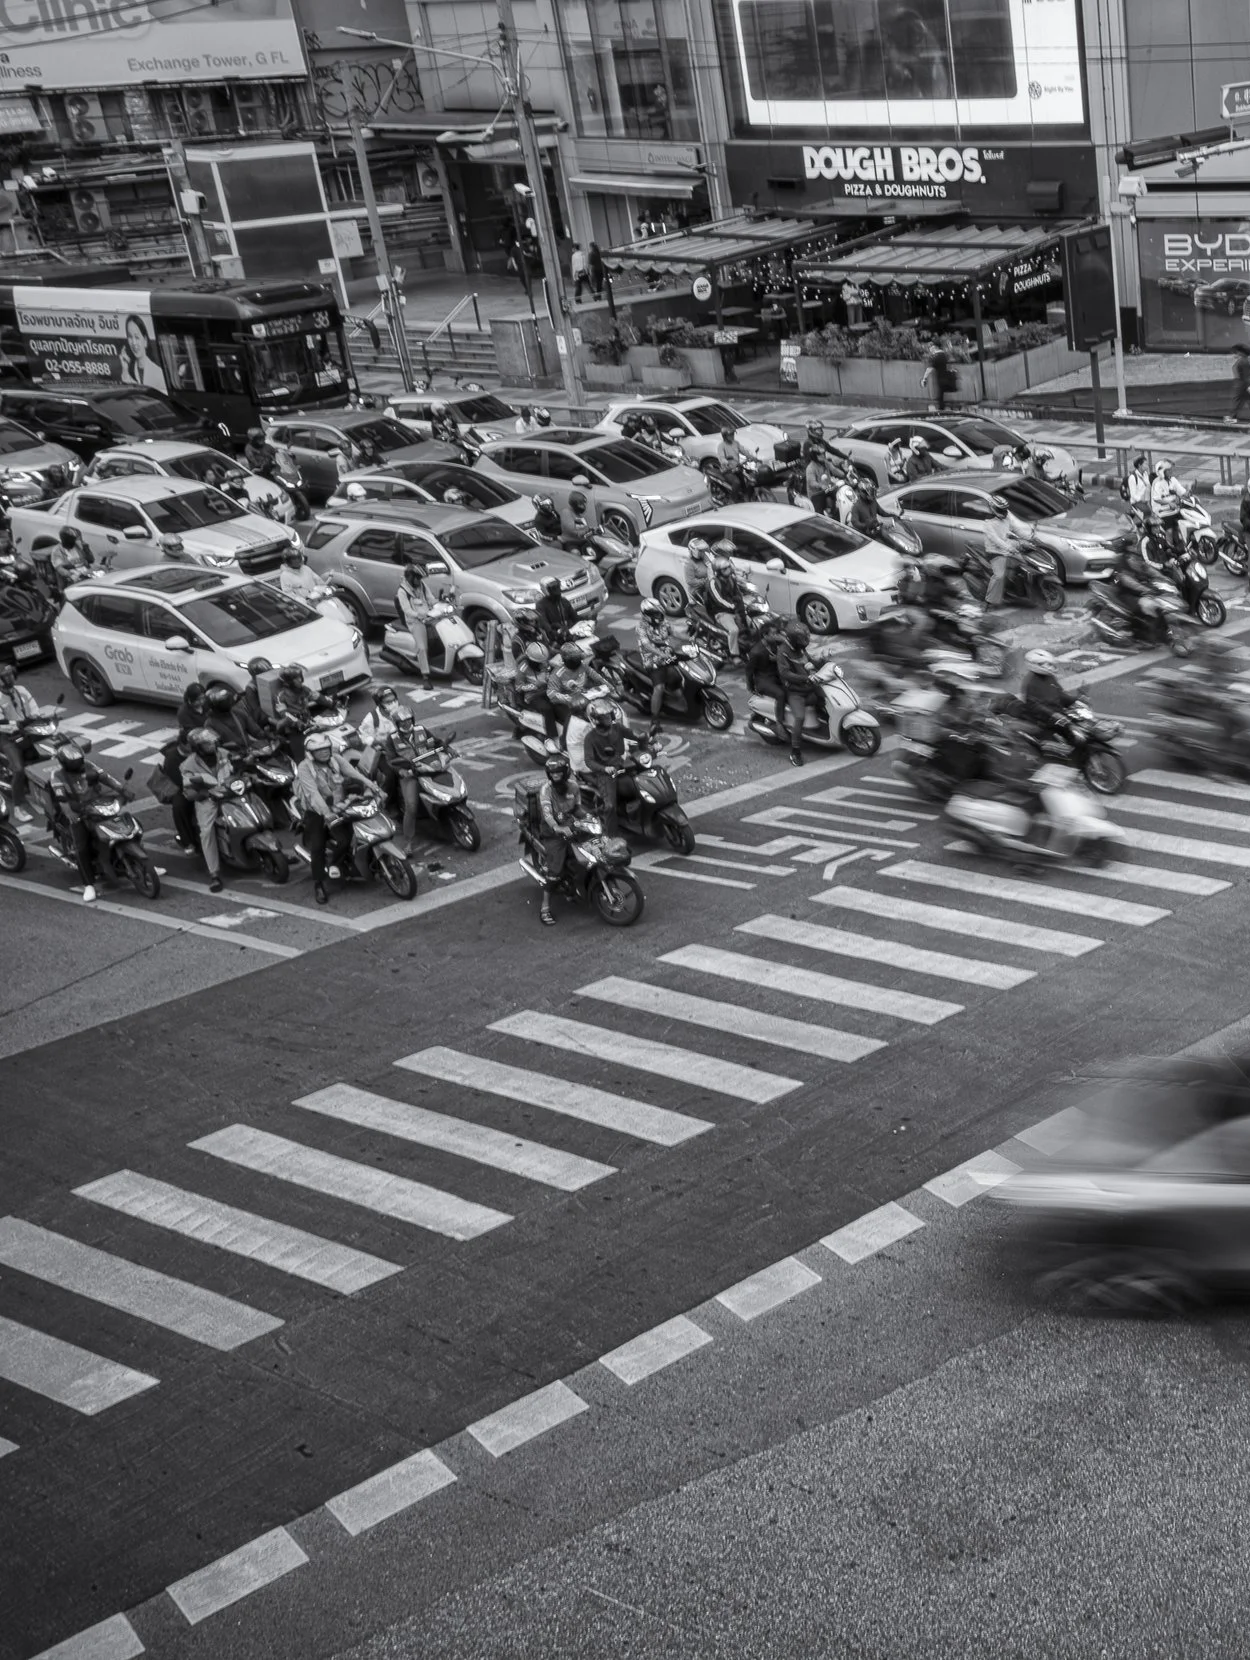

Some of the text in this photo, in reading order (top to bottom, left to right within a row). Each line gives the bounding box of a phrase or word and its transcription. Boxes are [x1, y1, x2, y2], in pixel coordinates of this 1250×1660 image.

[127, 51, 289, 73] Exchange Tower, G FL
[0, 65, 43, 79] llness
[802, 146, 987, 184] DOUGH BROS.
[844, 183, 947, 198] PIZZA & DOUGHNUTS
[1013, 263, 1033, 277] PIZZA
[1013, 272, 1051, 294] DOUGHNUTS
[44, 358, 111, 376] 02-055-8888
[104, 644, 134, 664] Grab
